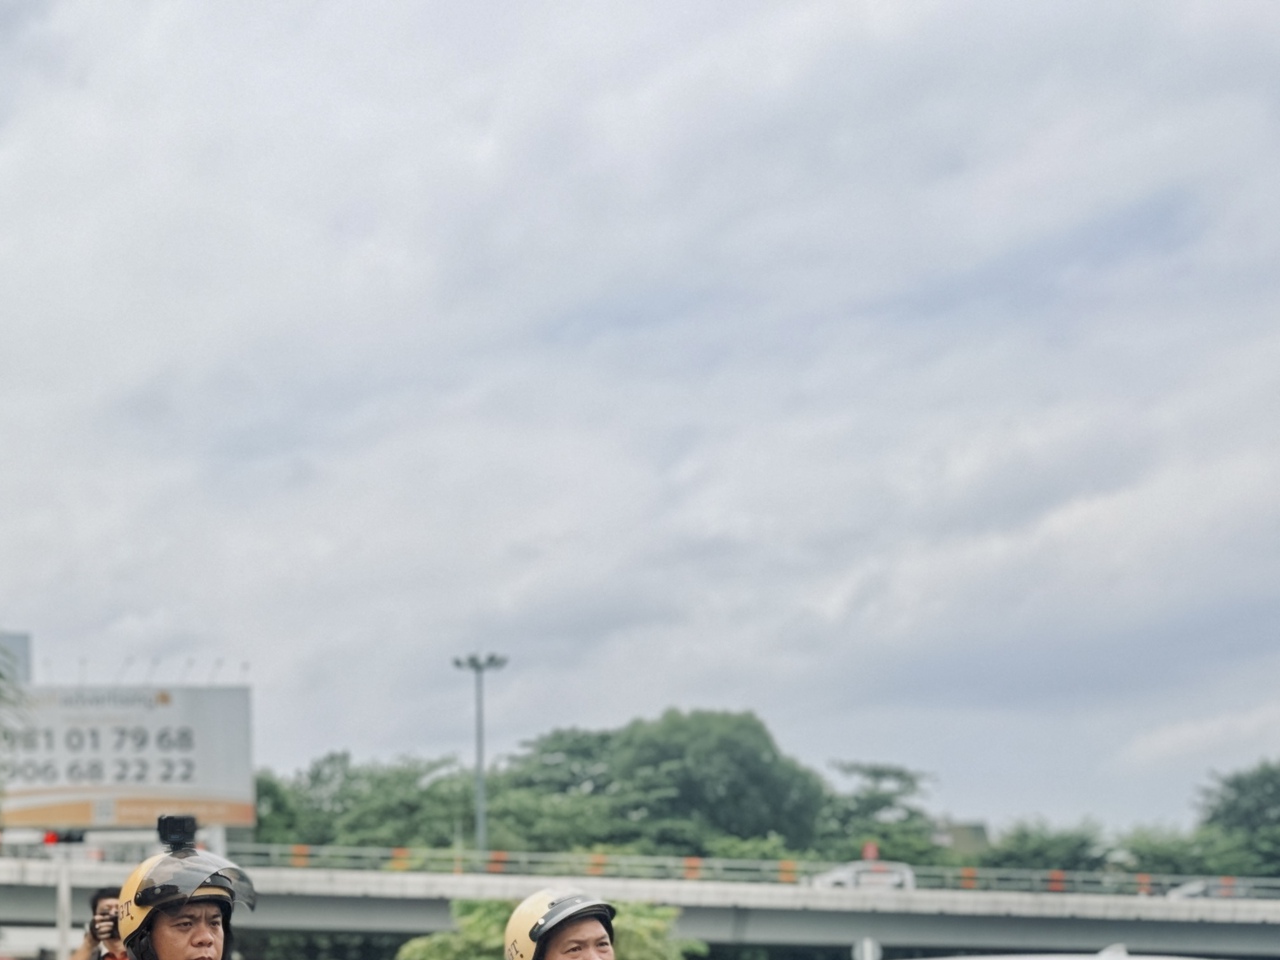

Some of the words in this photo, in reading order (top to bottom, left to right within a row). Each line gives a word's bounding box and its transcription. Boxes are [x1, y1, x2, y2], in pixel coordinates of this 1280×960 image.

[64, 727, 101, 752] 01
[111, 727, 150, 752] 79
[113, 758, 150, 782] 22
[159, 758, 196, 782] 22
